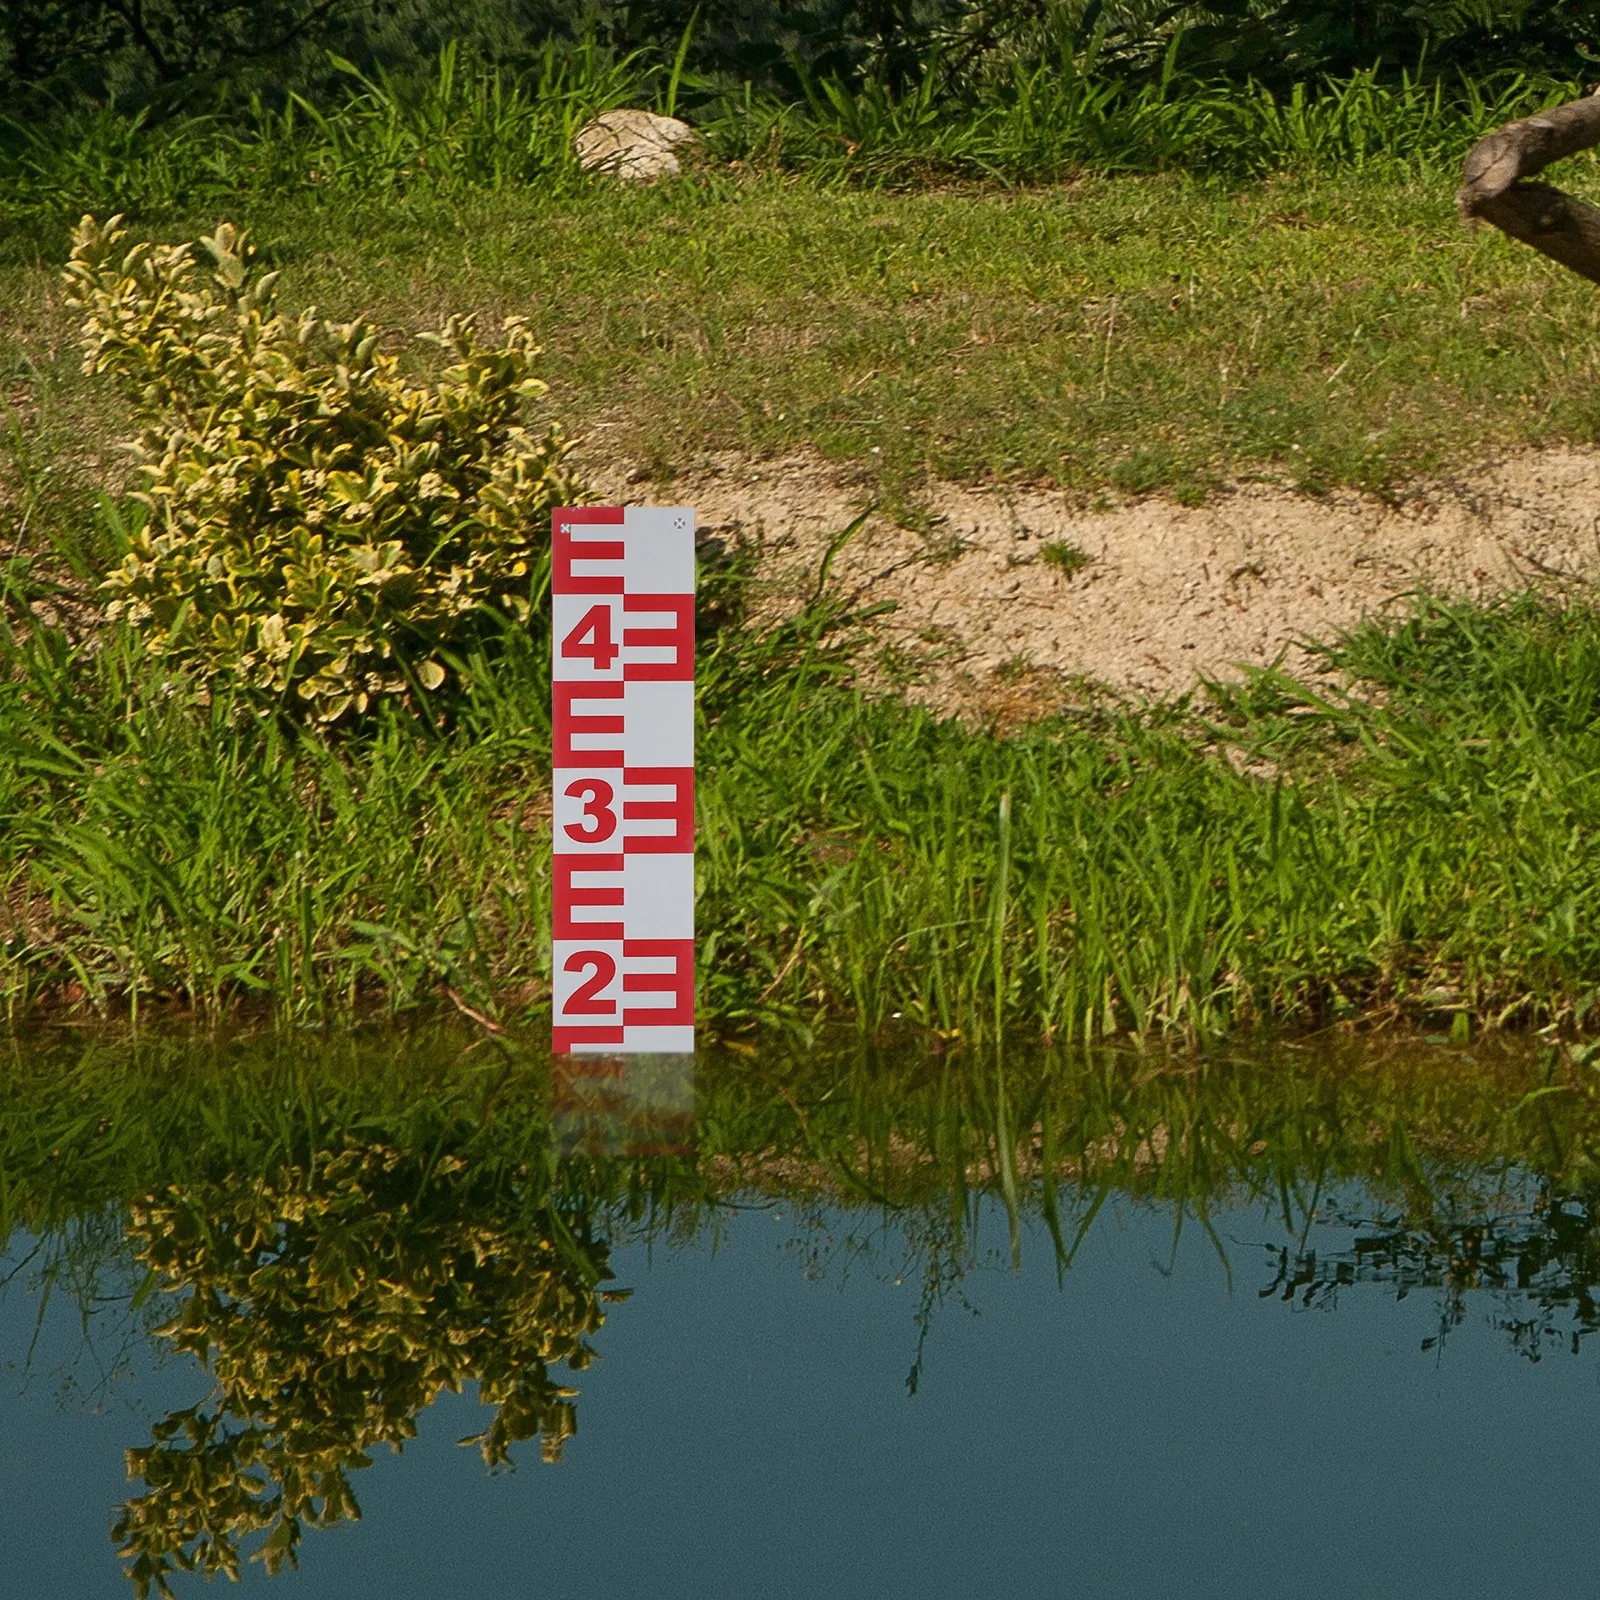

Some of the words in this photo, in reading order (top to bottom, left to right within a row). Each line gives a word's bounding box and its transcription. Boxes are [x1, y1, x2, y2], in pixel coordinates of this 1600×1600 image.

[561, 604, 619, 669] 4
[563, 778, 617, 843] 3
[562, 950, 617, 1015] 2
